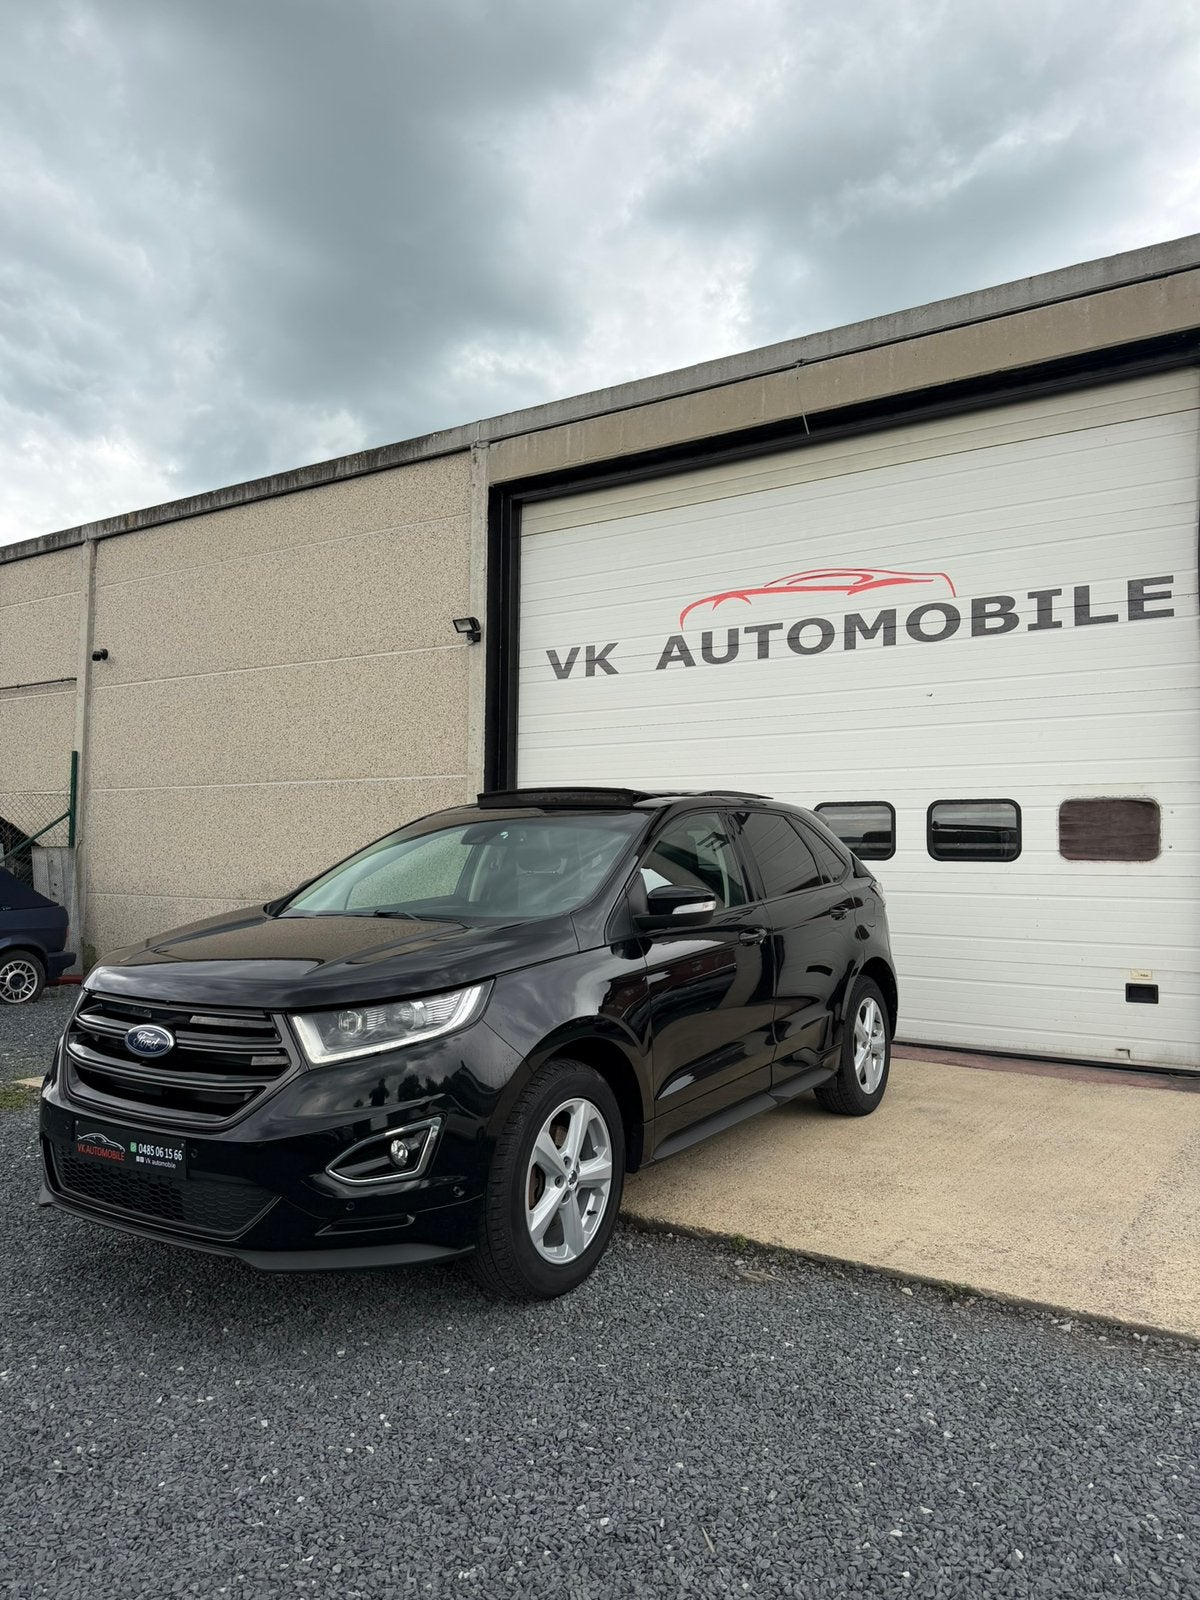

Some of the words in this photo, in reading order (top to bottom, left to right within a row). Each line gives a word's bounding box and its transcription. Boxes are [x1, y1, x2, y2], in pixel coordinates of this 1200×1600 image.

[546, 642, 619, 680] VK
[655, 575, 1175, 670] AUTOMOBILE
[133, 1031, 160, 1050] Ford
[77, 1143, 86, 1153] VK
[86, 1145, 125, 1161] AUTOMOBILE
[138, 1143, 154, 1156] 0485
[155, 1147, 164, 1157] 06
[165, 1149, 173, 1159] 15
[174, 1150, 183, 1161] 66
